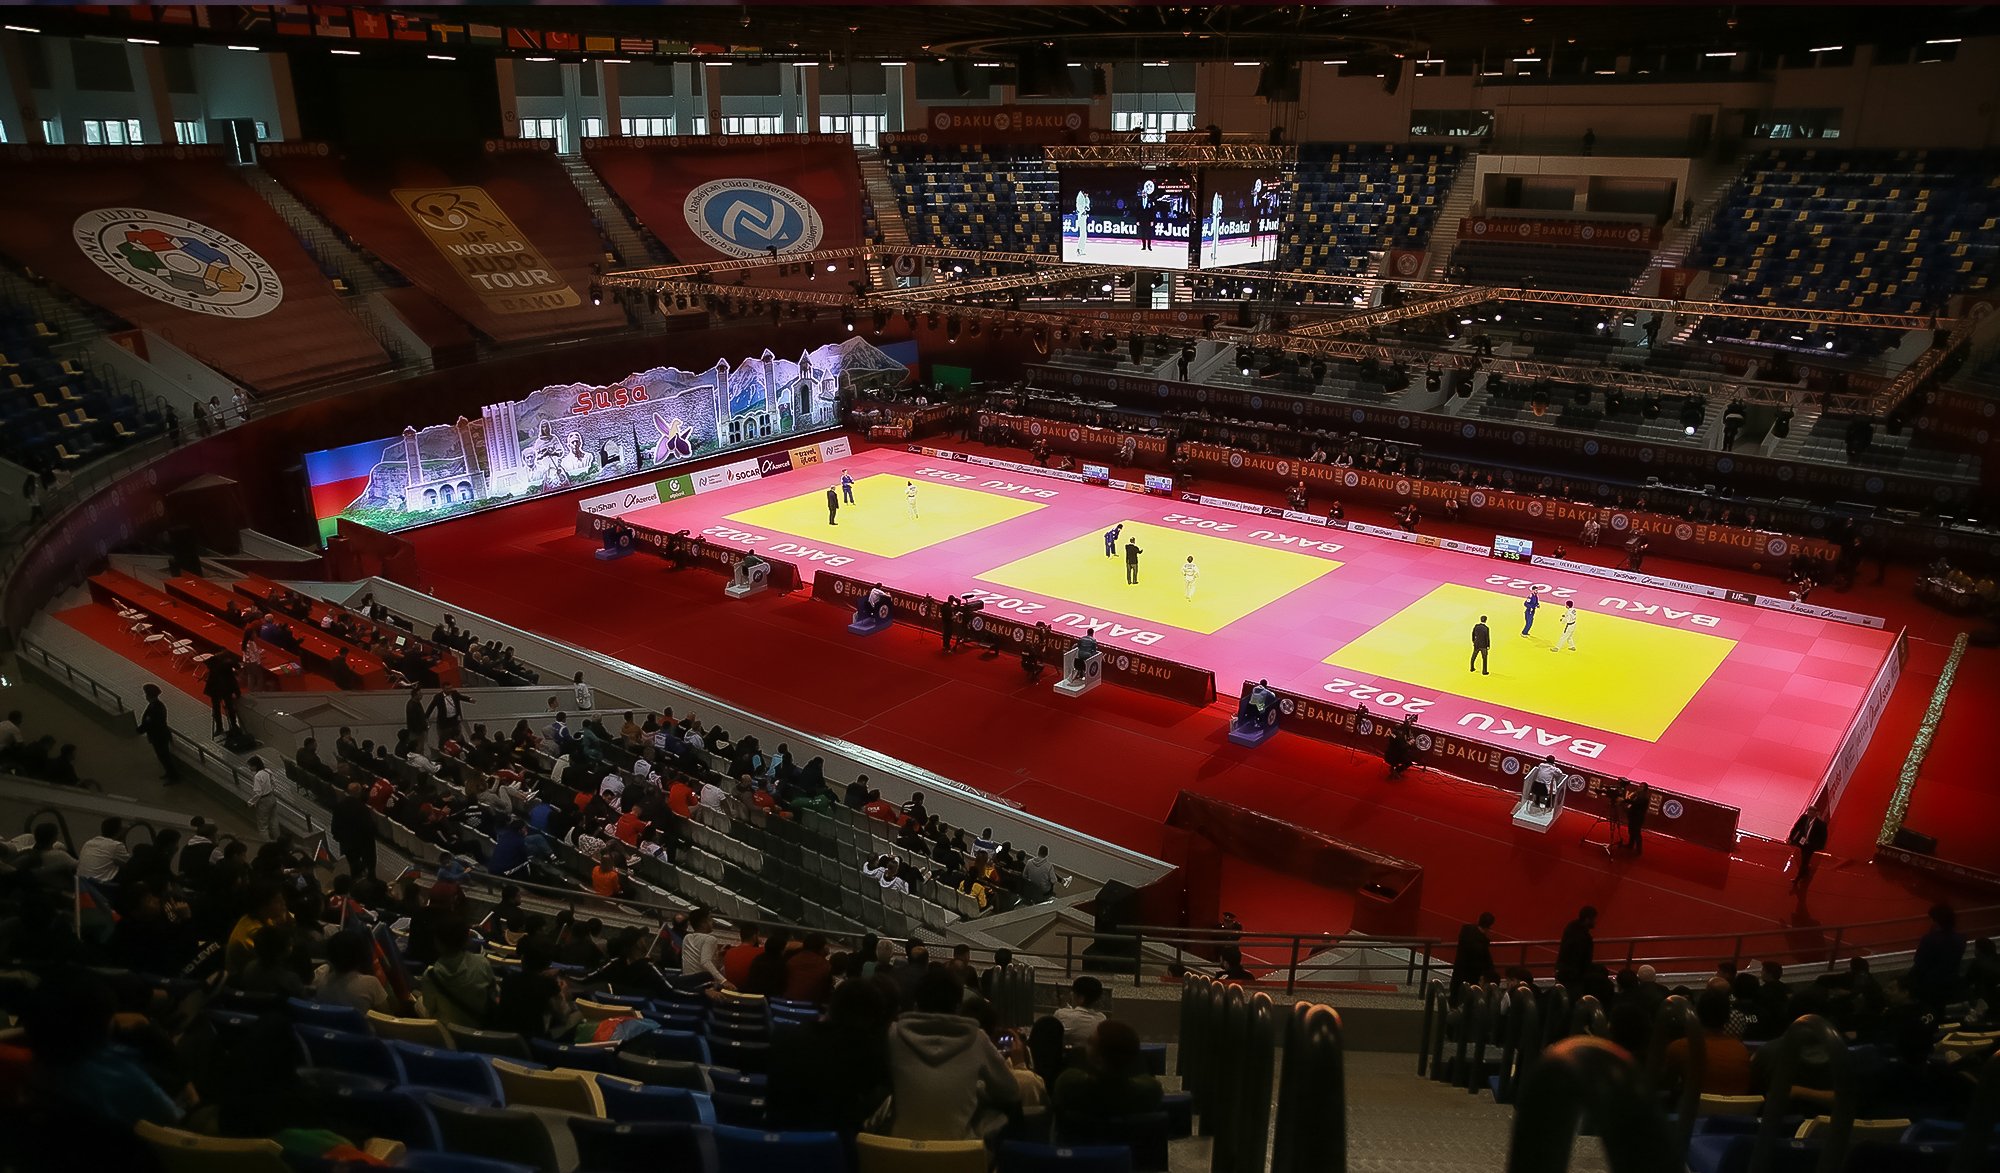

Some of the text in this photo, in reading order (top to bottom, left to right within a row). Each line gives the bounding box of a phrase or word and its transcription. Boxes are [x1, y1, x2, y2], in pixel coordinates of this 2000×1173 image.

[953, 115, 1063, 127] BAKU BAKU
[896, 134, 918, 142] BAKU
[95, 210, 148, 223] JUDO
[460, 230, 489, 243] IJF
[1062, 219, 1138, 235] #JdoBaku
[1202, 219, 1251, 237] #JdoBaku
[1488, 223, 1626, 240] BAKU BAKU BAKU
[447, 240, 525, 256] WORLD
[79, 221, 279, 316] INTERNATIONAL FEDERATION
[462, 252, 538, 274] JUDO
[471, 269, 556, 290] TOUR
[501, 293, 566, 310] BAKU
[1126, 382, 1150, 392] BAKU
[1170, 387, 1195, 398] BAKU
[1366, 412, 1397, 425] BAKU
[1421, 420, 1451, 433] BAKU
[1602, 442, 1636, 457] BAKU
[1667, 453, 1705, 467] BAKU
[1042, 425, 1068, 438] BAKU
[1089, 432, 1116, 445] BAKU
[1137, 440, 1166, 453] BAKU
[735, 467, 760, 481] SOCAR
[915, 467, 1060, 498] BAKU 2022
[587, 502, 617, 514] TaiShan
[633, 494, 658, 505] Azercell
[1191, 448, 1836, 562] BAKU BAKU BAKU BAKU BAKU BAKU BAKU BAKU BAKU BAKU
[1162, 513, 1345, 553] BAKU 2022
[701, 548, 720, 560] BAKU
[702, 525, 855, 567] BAKU 2022
[1504, 552, 1520, 560] 3:55
[1485, 574, 1721, 628] BAKU 2022
[960, 588, 1165, 646] BAKU 2022
[894, 597, 918, 612] BAKU
[985, 620, 1012, 636] BAKU
[1140, 664, 1172, 680] BAKU
[1324, 678, 1608, 759] BAKU 2022
[1307, 707, 1344, 726] BAKU
[1448, 744, 1488, 764] BAKU
